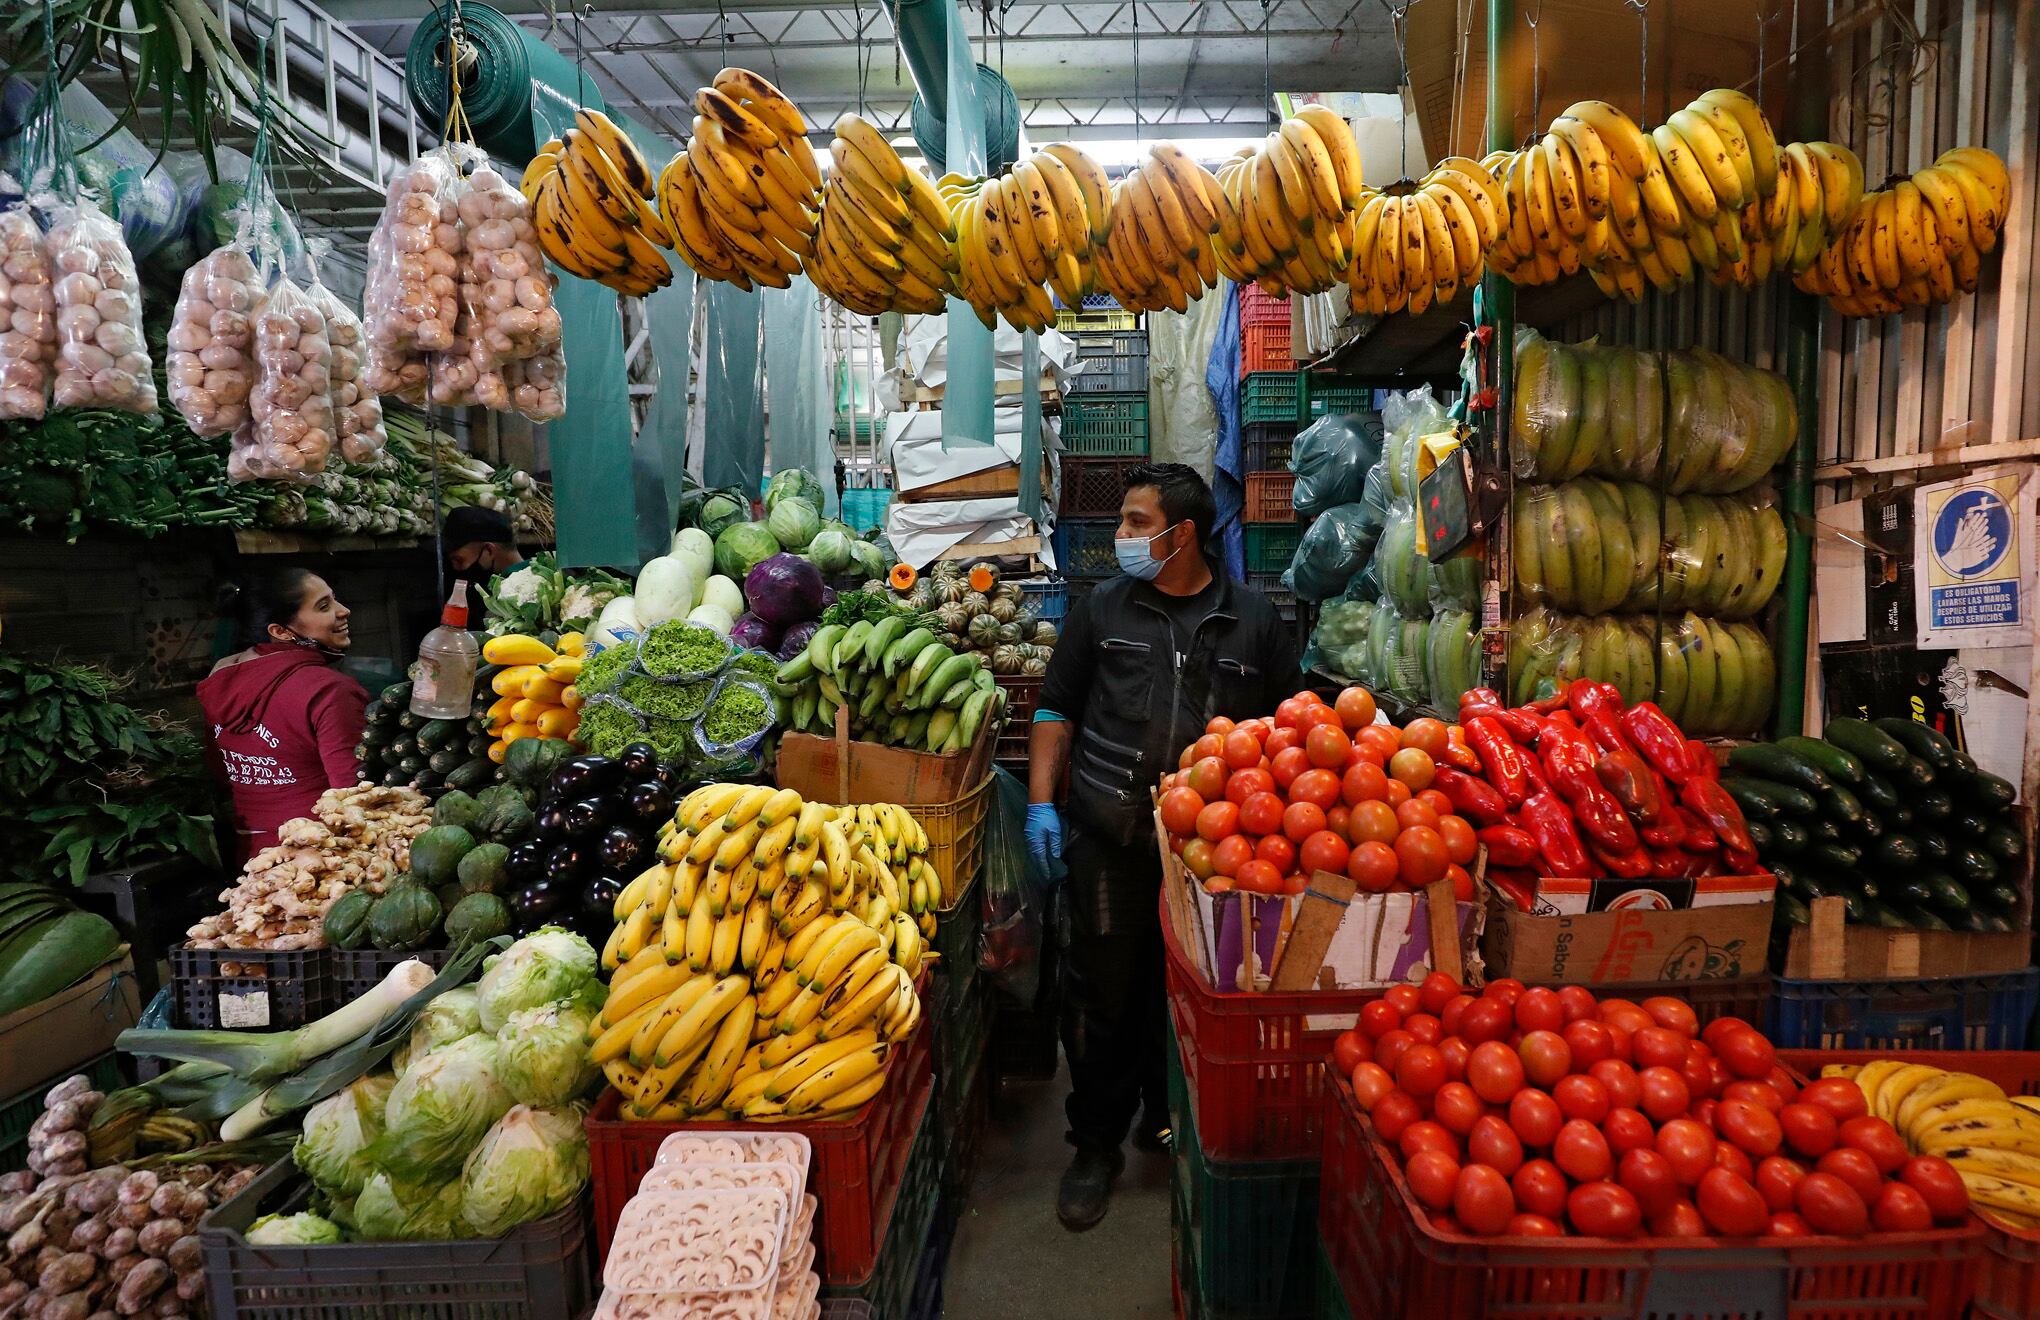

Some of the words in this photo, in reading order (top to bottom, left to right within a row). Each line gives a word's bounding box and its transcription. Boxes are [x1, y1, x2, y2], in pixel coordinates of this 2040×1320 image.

[1955, 585, 2001, 597] OBLIGATORIO
[1938, 598, 1966, 607] LAVARSE
[1968, 596, 1982, 605] LAS
[1983, 593, 2011, 603] MANOS
[1937, 606, 1966, 616] DESPUES
[1968, 605, 1977, 614] DE
[1980, 603, 2012, 613] UTILIZAR
[1944, 615, 1965, 625] ESTOS
[1966, 613, 2004, 623] SERVICIOS
[278, 767, 292, 778] 43
[1552, 933, 1574, 979] Sabor
